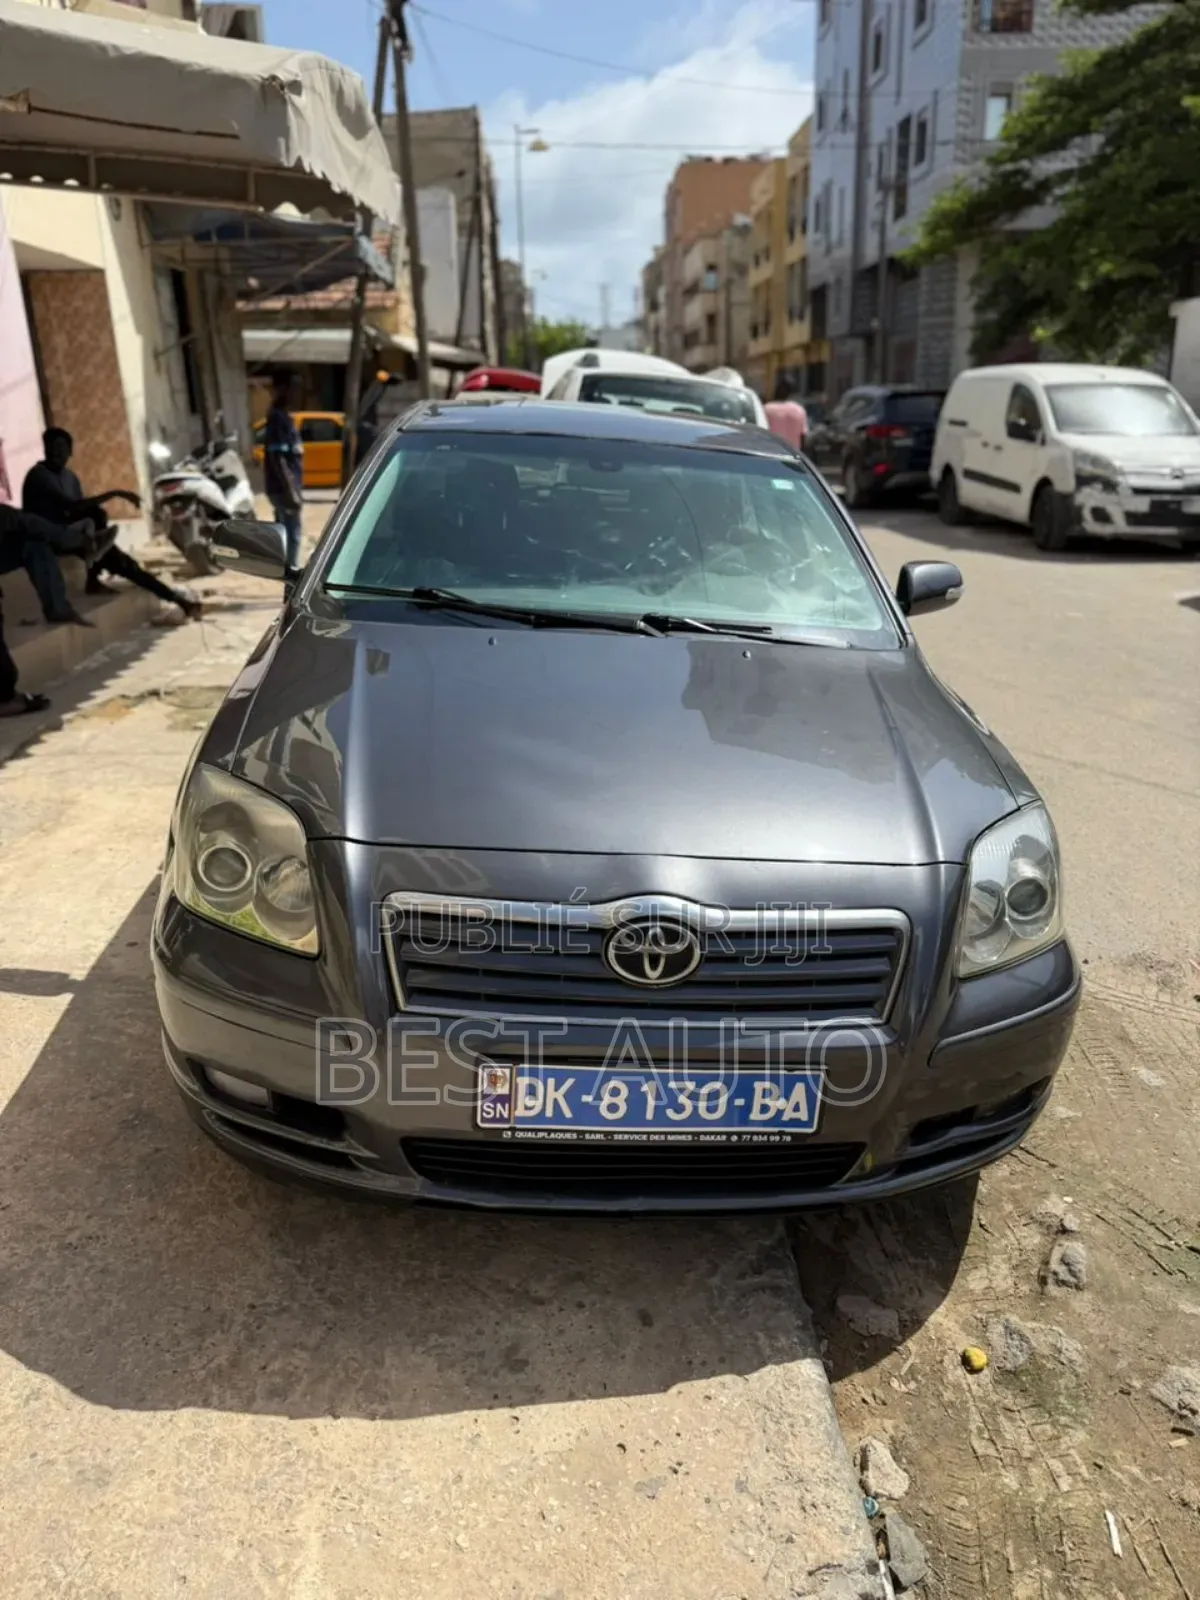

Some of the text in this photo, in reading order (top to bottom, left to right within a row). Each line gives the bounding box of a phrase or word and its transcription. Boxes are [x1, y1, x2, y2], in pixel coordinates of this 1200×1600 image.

[482, 1102, 509, 1119] SN
[515, 1131, 577, 1140] QUALIPLAQUES
[585, 1133, 606, 1141] SARL
[613, 1133, 649, 1141] SERVICE
